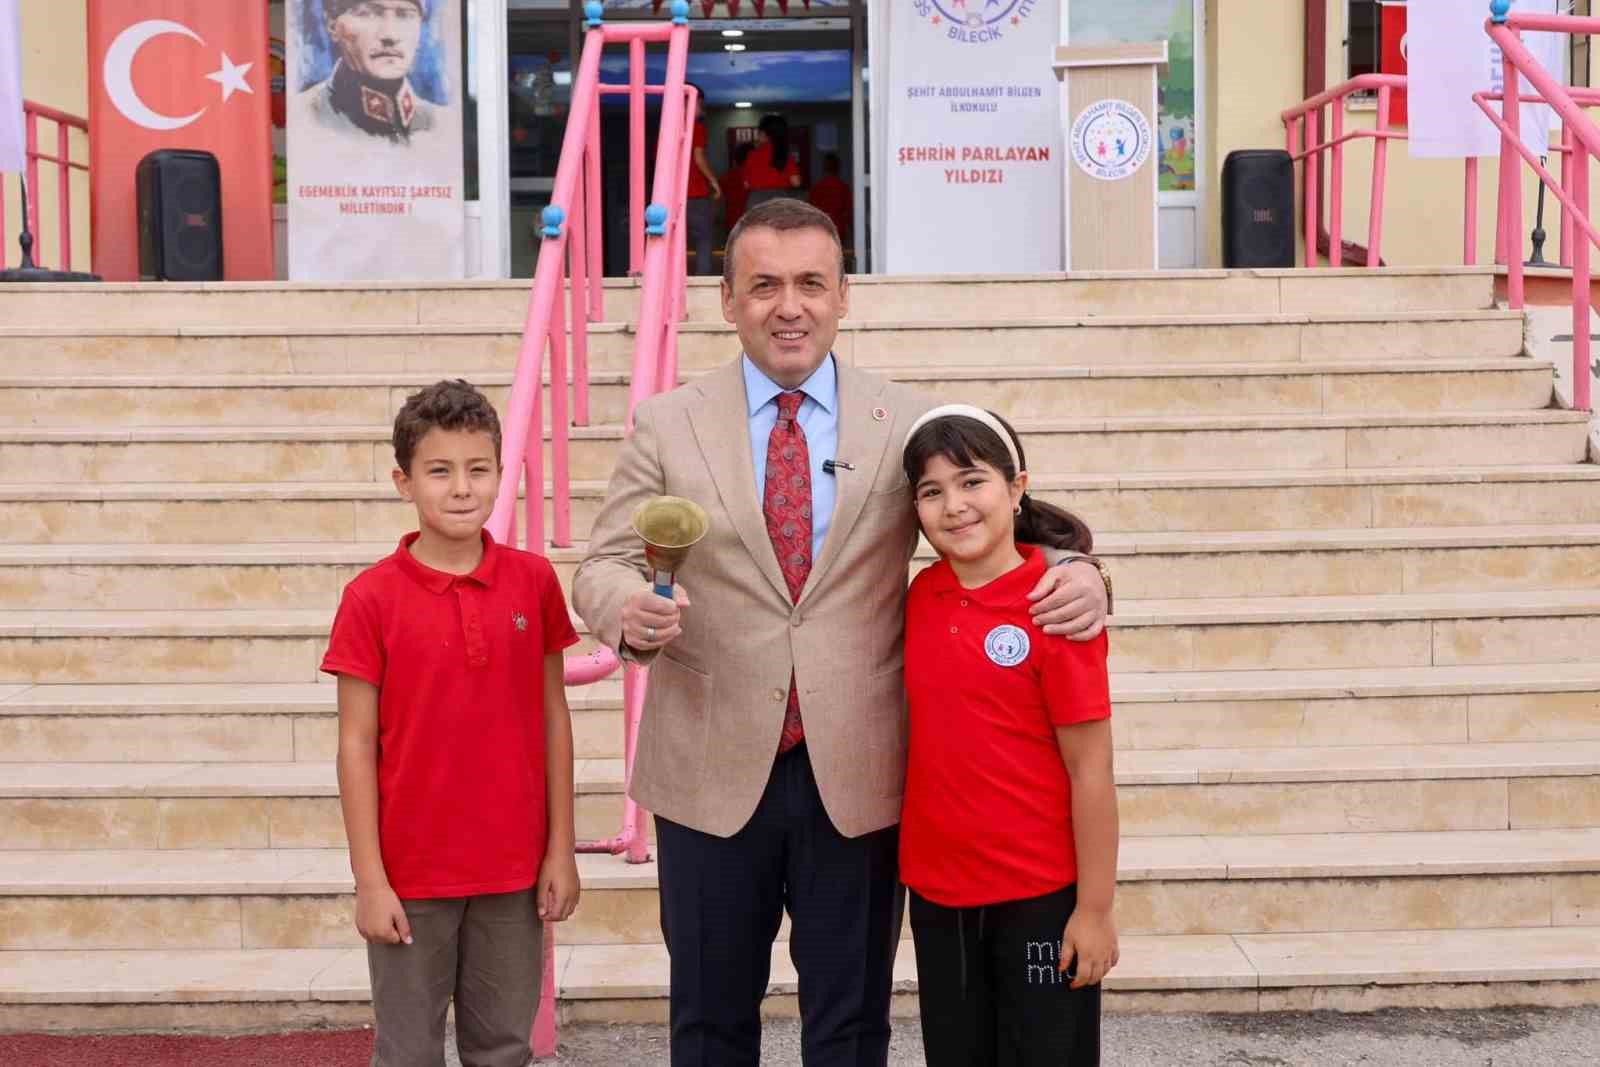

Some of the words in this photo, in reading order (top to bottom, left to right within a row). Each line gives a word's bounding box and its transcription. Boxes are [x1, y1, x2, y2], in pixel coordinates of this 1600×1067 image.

[947, 25, 1003, 43] BİLECİK
[907, 86, 935, 99] ŞEHİT
[1007, 85, 1042, 97] BİLGEN
[898, 143, 956, 165] ŞEHRİN
[962, 147, 1050, 161] PARLAYAN
[945, 169, 1004, 184] YILDIZI
[361, 186, 406, 198] KAYITSIZ
[410, 186, 453, 200] ŞARTSIZ
